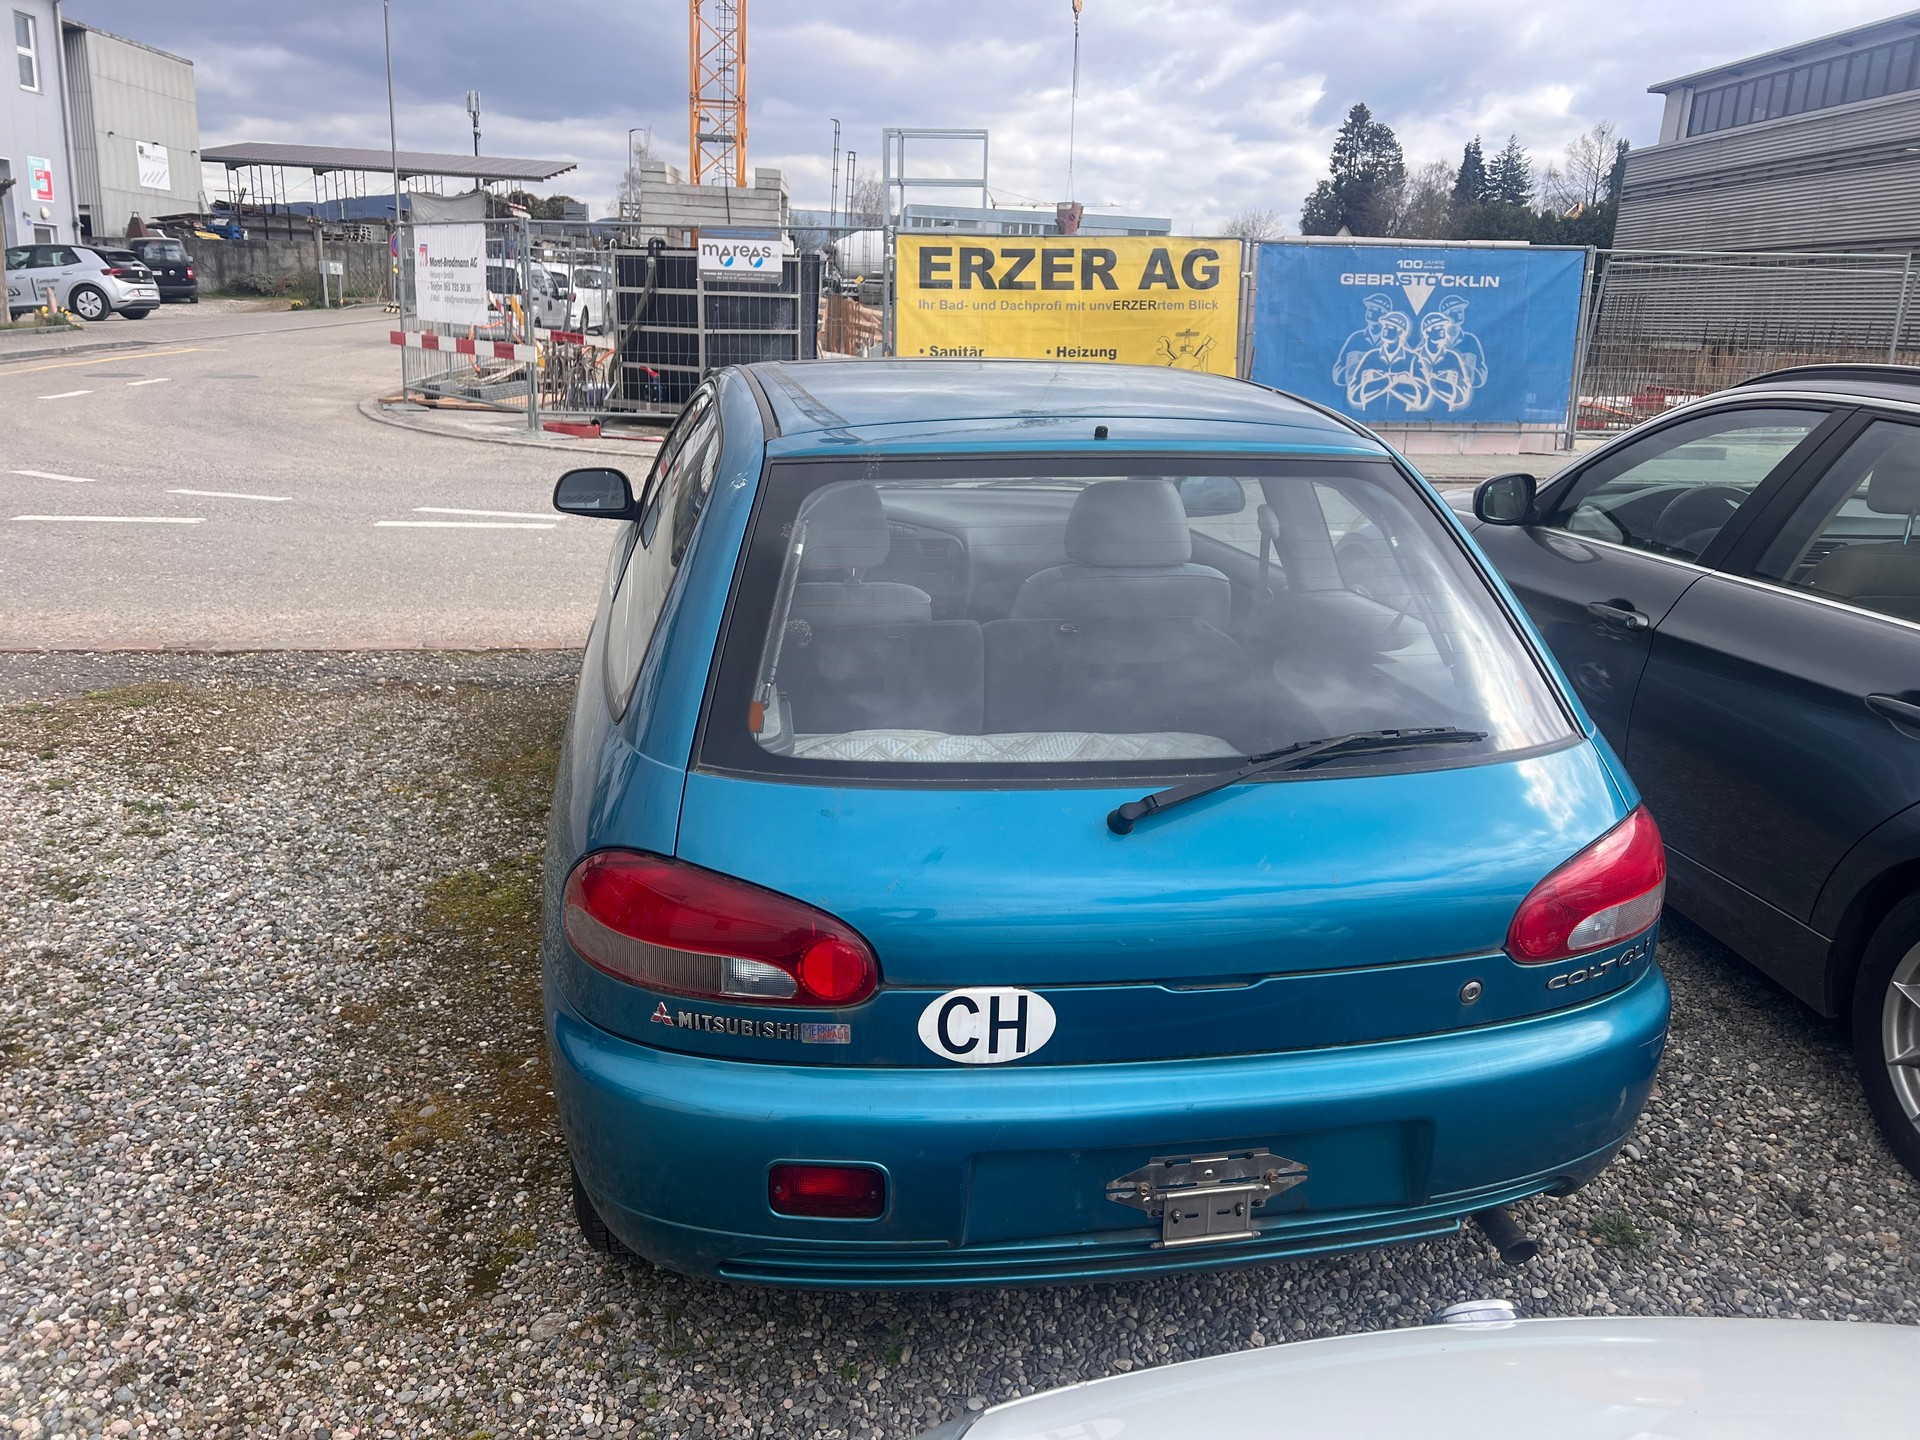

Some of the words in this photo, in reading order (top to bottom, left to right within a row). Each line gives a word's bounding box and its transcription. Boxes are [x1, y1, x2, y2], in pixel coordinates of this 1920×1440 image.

[470, 257, 478, 268] AG
[702, 244, 772, 268] mareas
[919, 246, 1119, 290] ERZER
[1138, 247, 1220, 290] AG
[1396, 259, 1423, 269] 100
[918, 299, 935, 310] Ihr
[939, 299, 969, 311] Bad-
[972, 300, 996, 311] und
[1000, 300, 1062, 313] Dachprofi
[1065, 300, 1086, 311] mit
[1089, 299, 1185, 311] unvERZERrtem
[1188, 299, 1219, 311] Blick
[929, 345, 984, 357] Sanitär
[1056, 346, 1117, 360] Heizung
[1547, 958, 1617, 990] COLT
[678, 1010, 800, 1041] MITSUBISHI
[937, 994, 1028, 1055] CH
